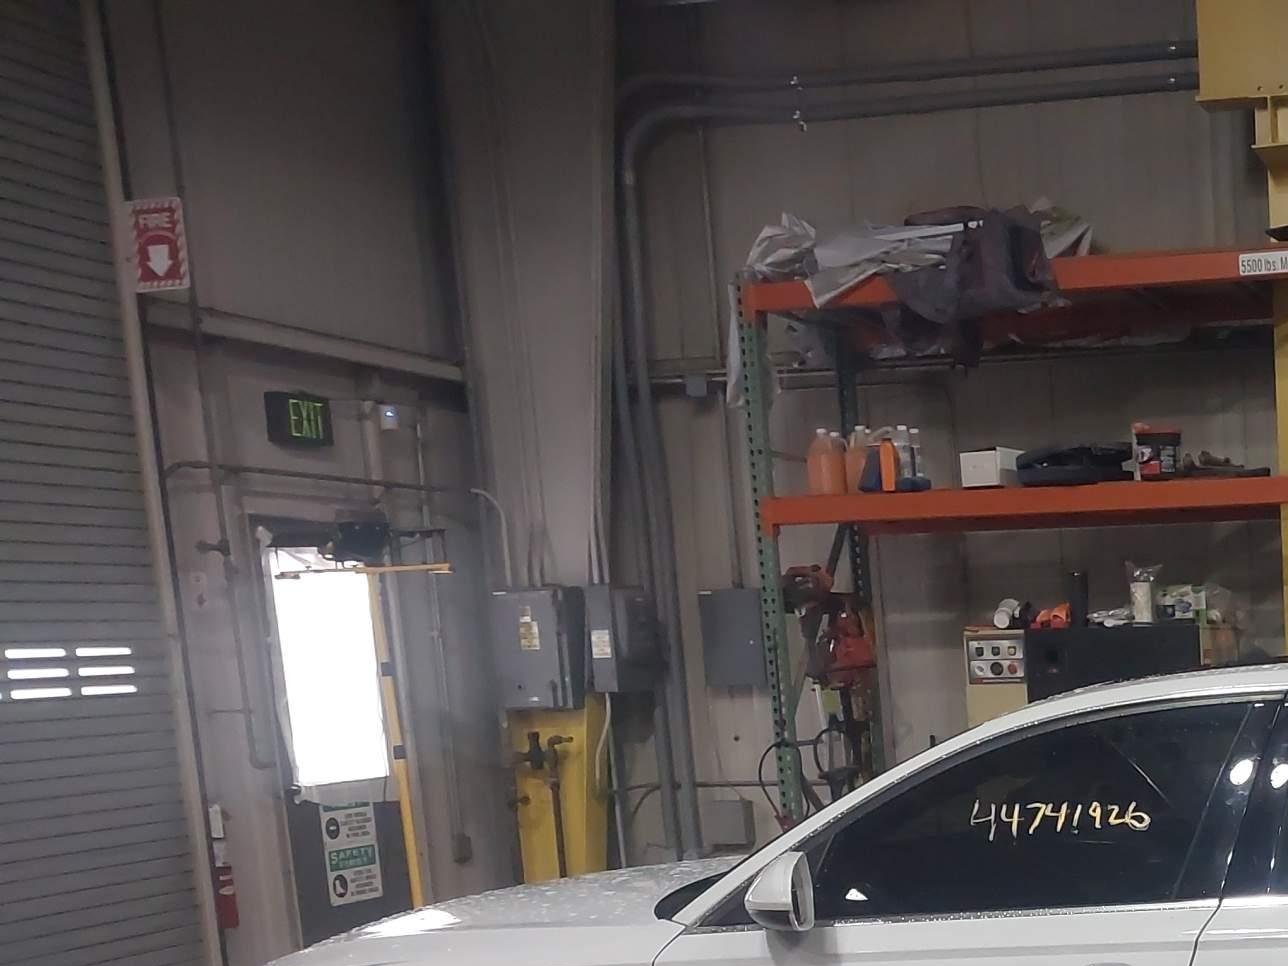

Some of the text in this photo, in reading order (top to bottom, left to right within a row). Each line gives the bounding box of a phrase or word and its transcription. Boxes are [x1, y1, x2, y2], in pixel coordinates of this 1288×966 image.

[1241, 259, 1263, 273] 5500
[289, 399, 323, 439] EXIT
[331, 847, 372, 864] SAFETY
